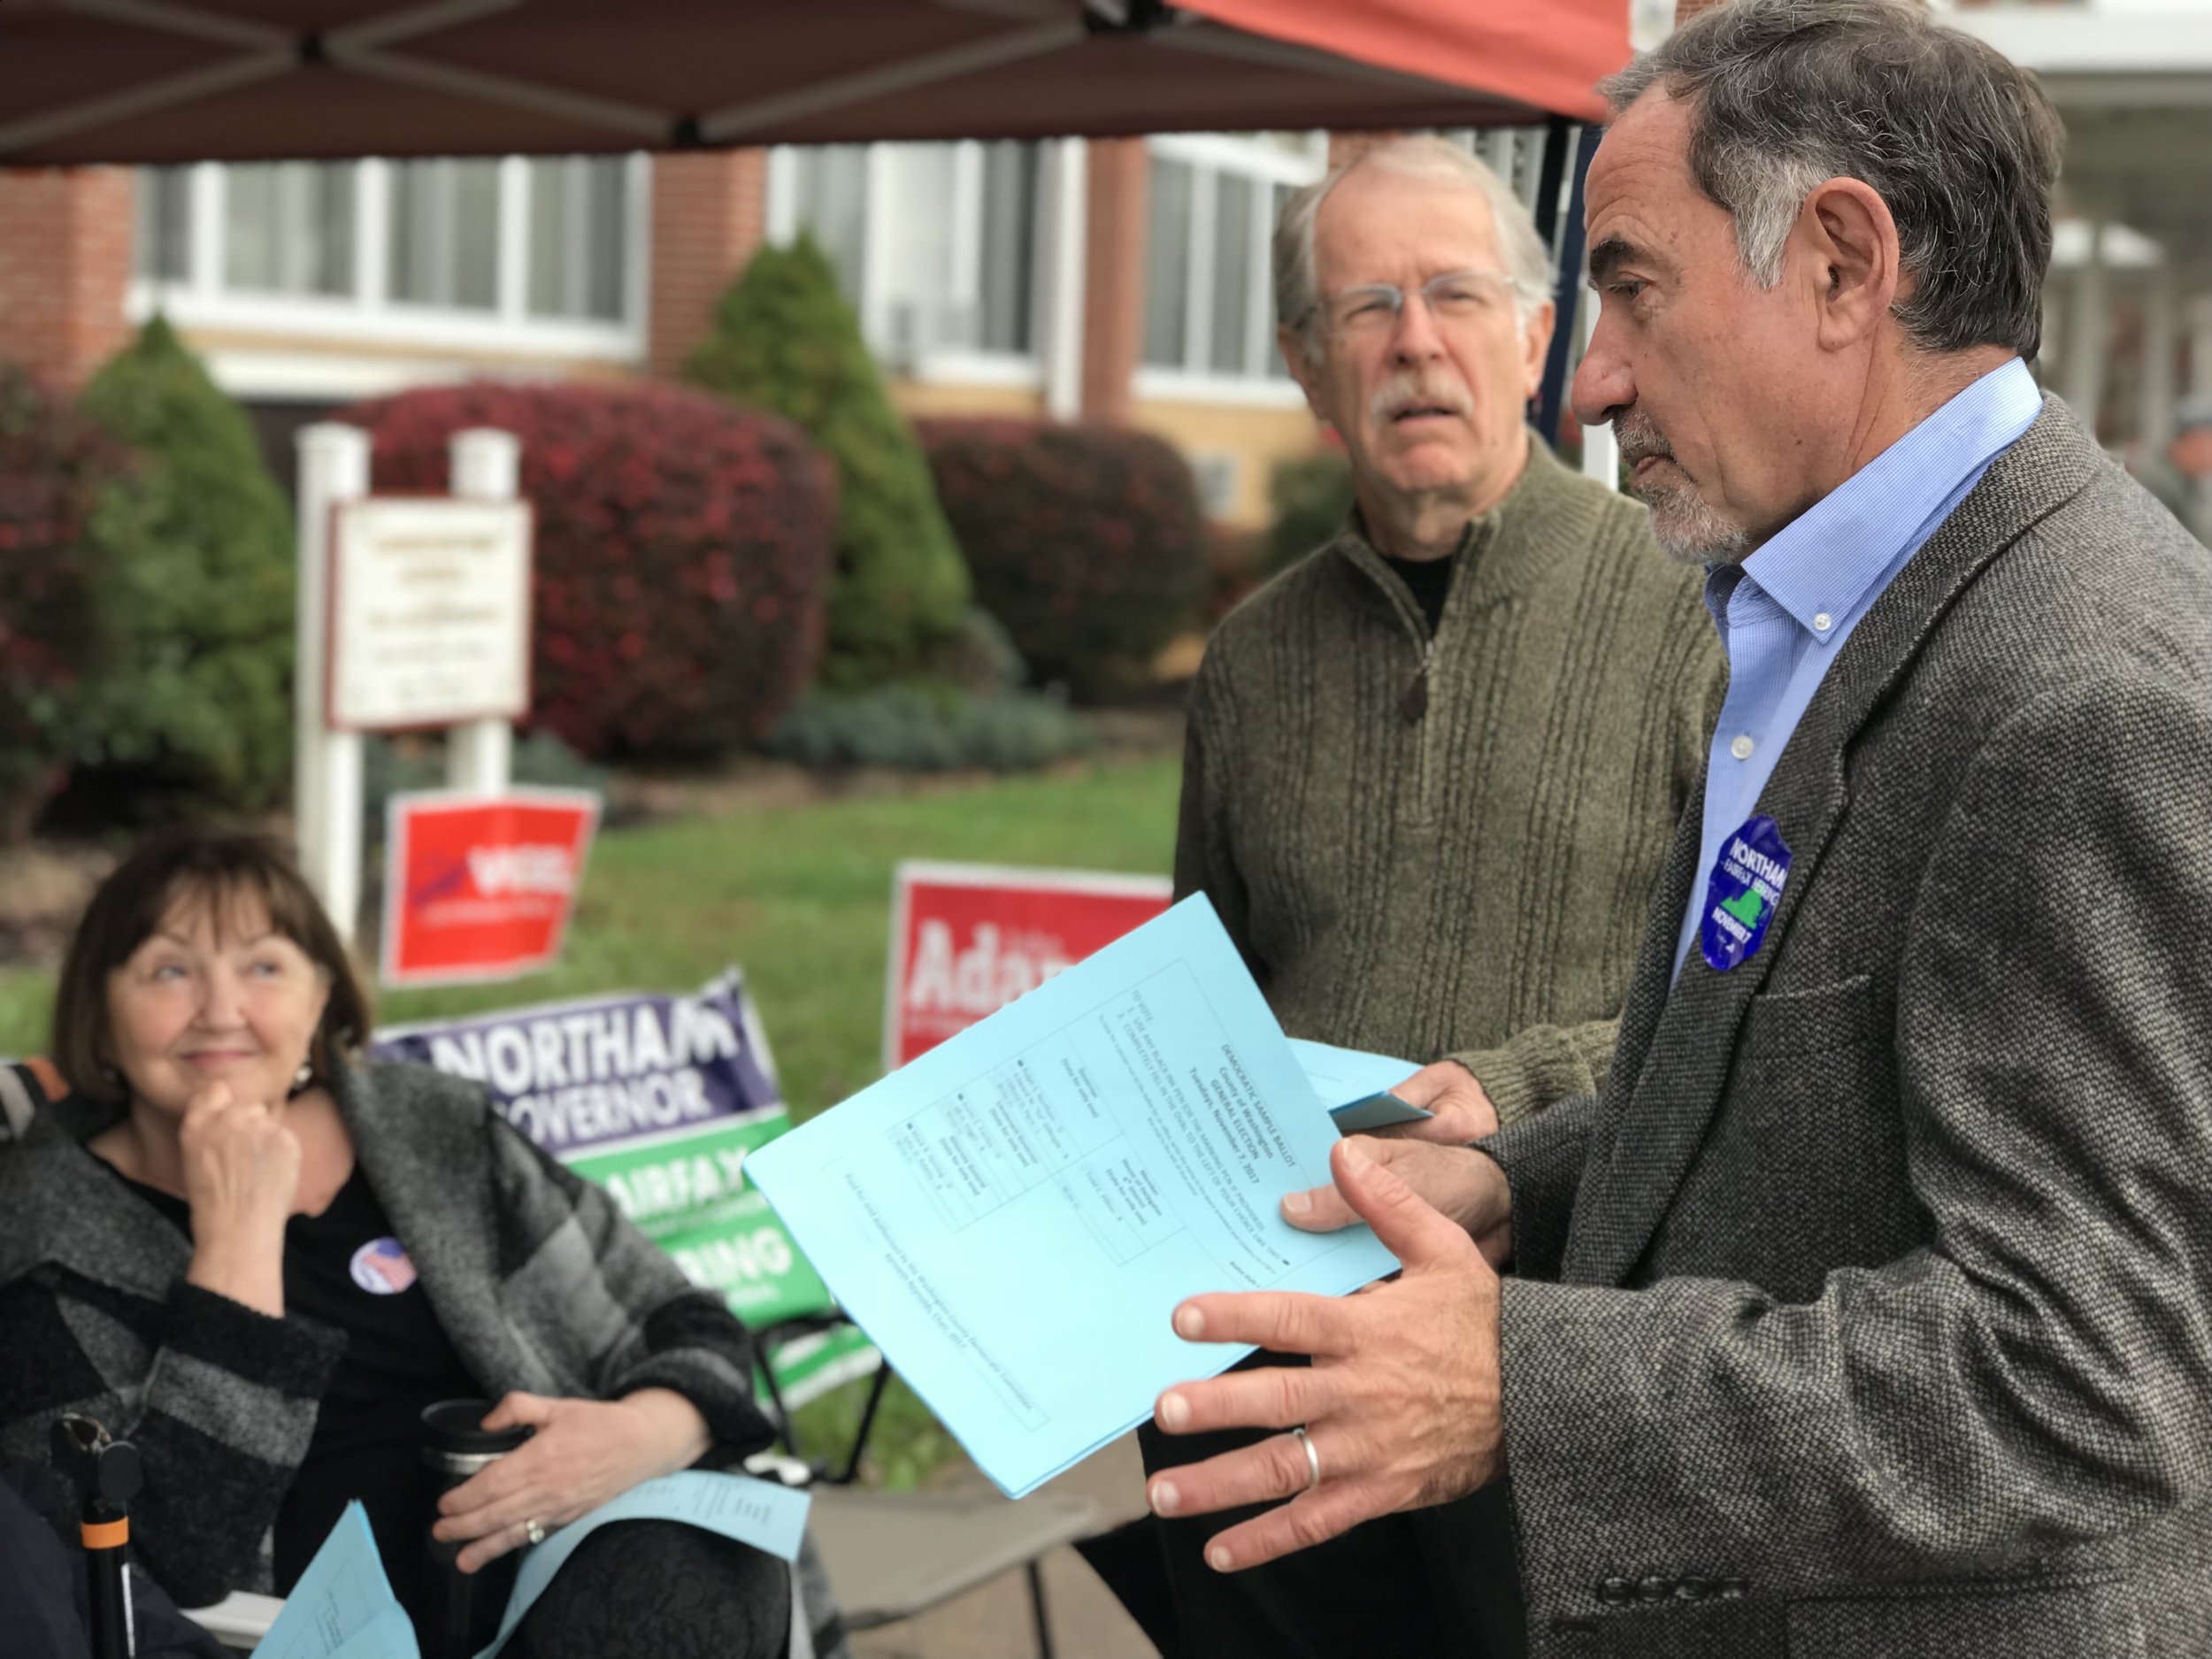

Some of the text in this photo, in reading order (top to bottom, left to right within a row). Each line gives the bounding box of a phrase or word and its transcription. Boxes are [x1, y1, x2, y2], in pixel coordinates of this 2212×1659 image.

[1730, 837, 1787, 890] NORTHAM
[430, 998, 739, 1095] NORTHAM
[493, 1066, 713, 1145] OVERNOR
[1121, 1023, 1155, 1071] COMPLETELY
[1149, 1071, 1163, 1086] FILL
[1172, 1111, 1188, 1132] OVAL
[1201, 1158, 1215, 1176] LEFT
[1218, 1186, 1237, 1208] YOUR
[1233, 1206, 1255, 1234] CHOICE
[1252, 1233, 1265, 1248] LIKE
[1151, 1050, 1168, 1073] BLACK
[1199, 1133, 1224, 1169] MARKING
[1187, 1067, 1217, 1110] Tuesdays,
[1211, 1109, 1241, 1153] November
[1243, 1163, 1259, 1184] 2017
[1210, 1079, 1260, 1159] GENERAL ELECTION
[1217, 1066, 1240, 1097] County
[1240, 1108, 1275, 1159] Washington
[1220, 1043, 1295, 1168] DEMOCRATIC SAMPLE BALLOT
[606, 1145, 748, 1223] AIRFAX
[674, 1225, 793, 1290] RING
